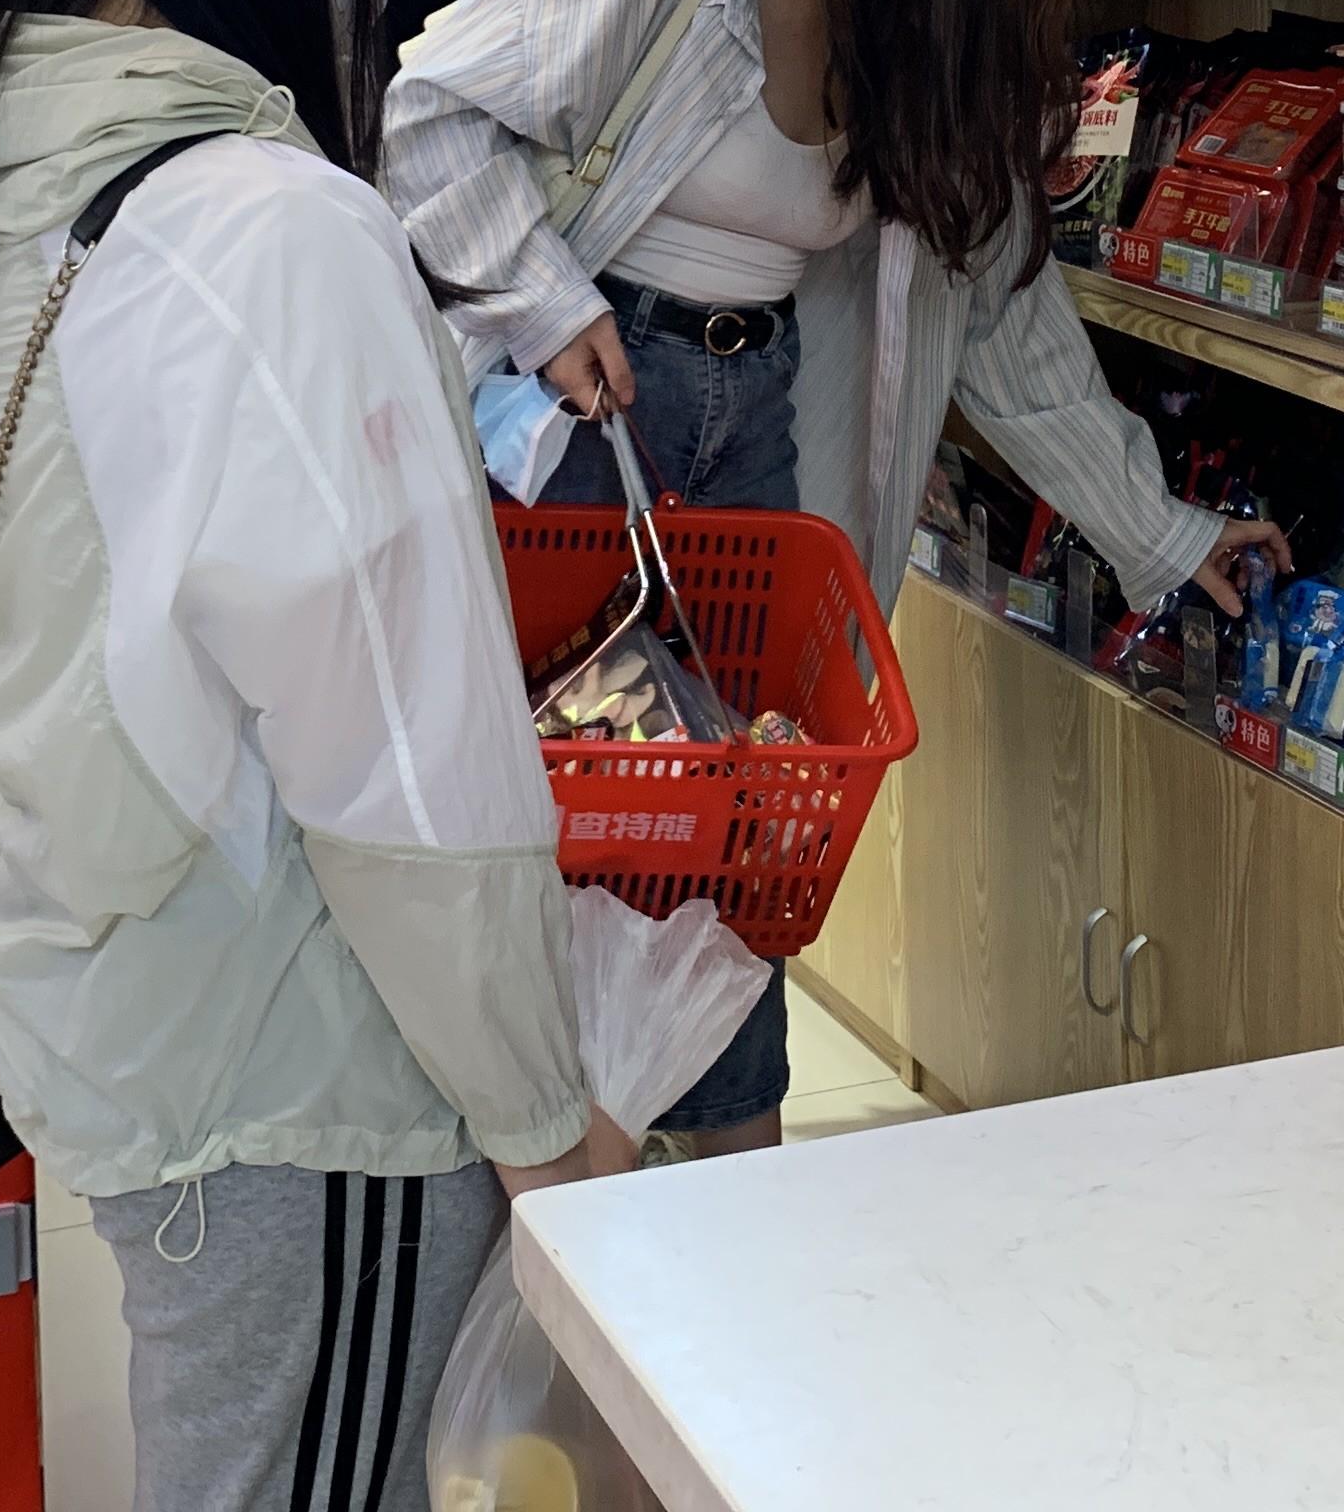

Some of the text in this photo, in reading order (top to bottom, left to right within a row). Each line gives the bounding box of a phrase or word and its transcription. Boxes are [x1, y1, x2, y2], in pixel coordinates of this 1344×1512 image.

[1122, 238, 1151, 267] 特色
[1240, 716, 1271, 753] 特色
[566, 810, 698, 842] 查特熊
